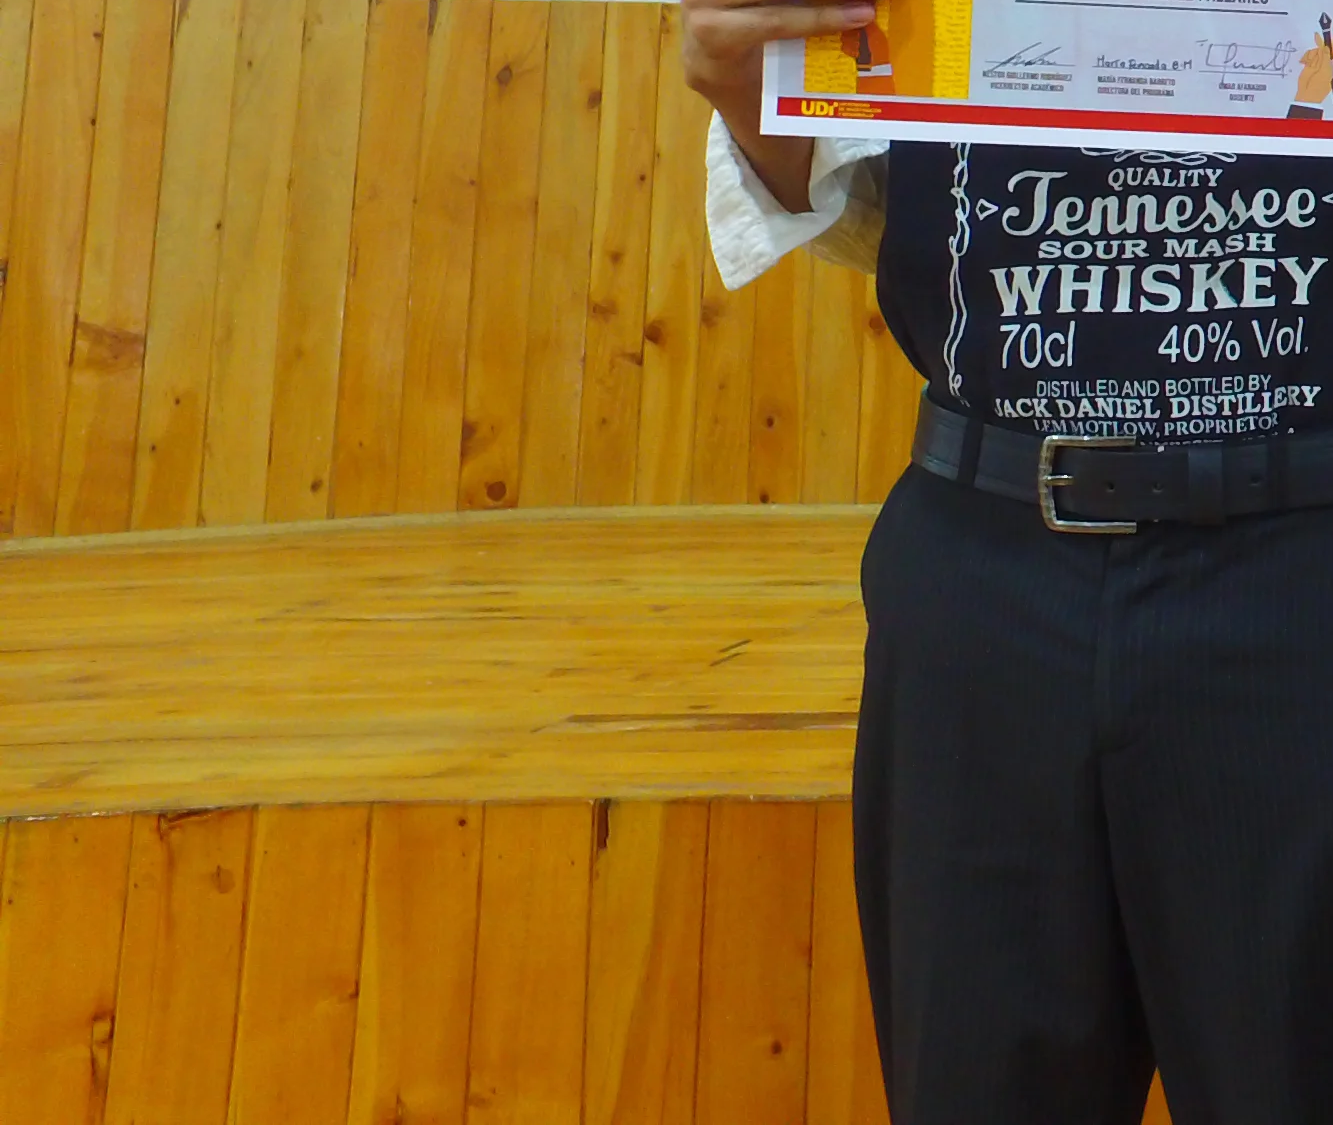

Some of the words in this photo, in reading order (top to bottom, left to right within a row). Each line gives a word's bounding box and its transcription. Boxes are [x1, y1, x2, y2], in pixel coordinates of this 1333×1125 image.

[1107, 167, 1224, 191] QUALITY
[1002, 169, 1317, 237] Tennessee
[1037, 238, 1150, 260] SOUR
[1163, 232, 1277, 258] MASH
[989, 255, 1329, 318] WHISKEY
[999, 320, 1077, 370] 70cl
[1158, 319, 1242, 364] 40%
[1251, 316, 1310, 357] Vol.
[1036, 379, 1118, 398] DISTILLED
[1121, 379, 1160, 397] AND
[1165, 376, 1244, 397] BOTTLED
[1248, 374, 1272, 391] BY
[994, 397, 1054, 418] JACK
[1056, 397, 1161, 418] DANIEL
[1169, 385, 1322, 419] DISTILLERY
[1164, 412, 1279, 436] PROPRIETOR
